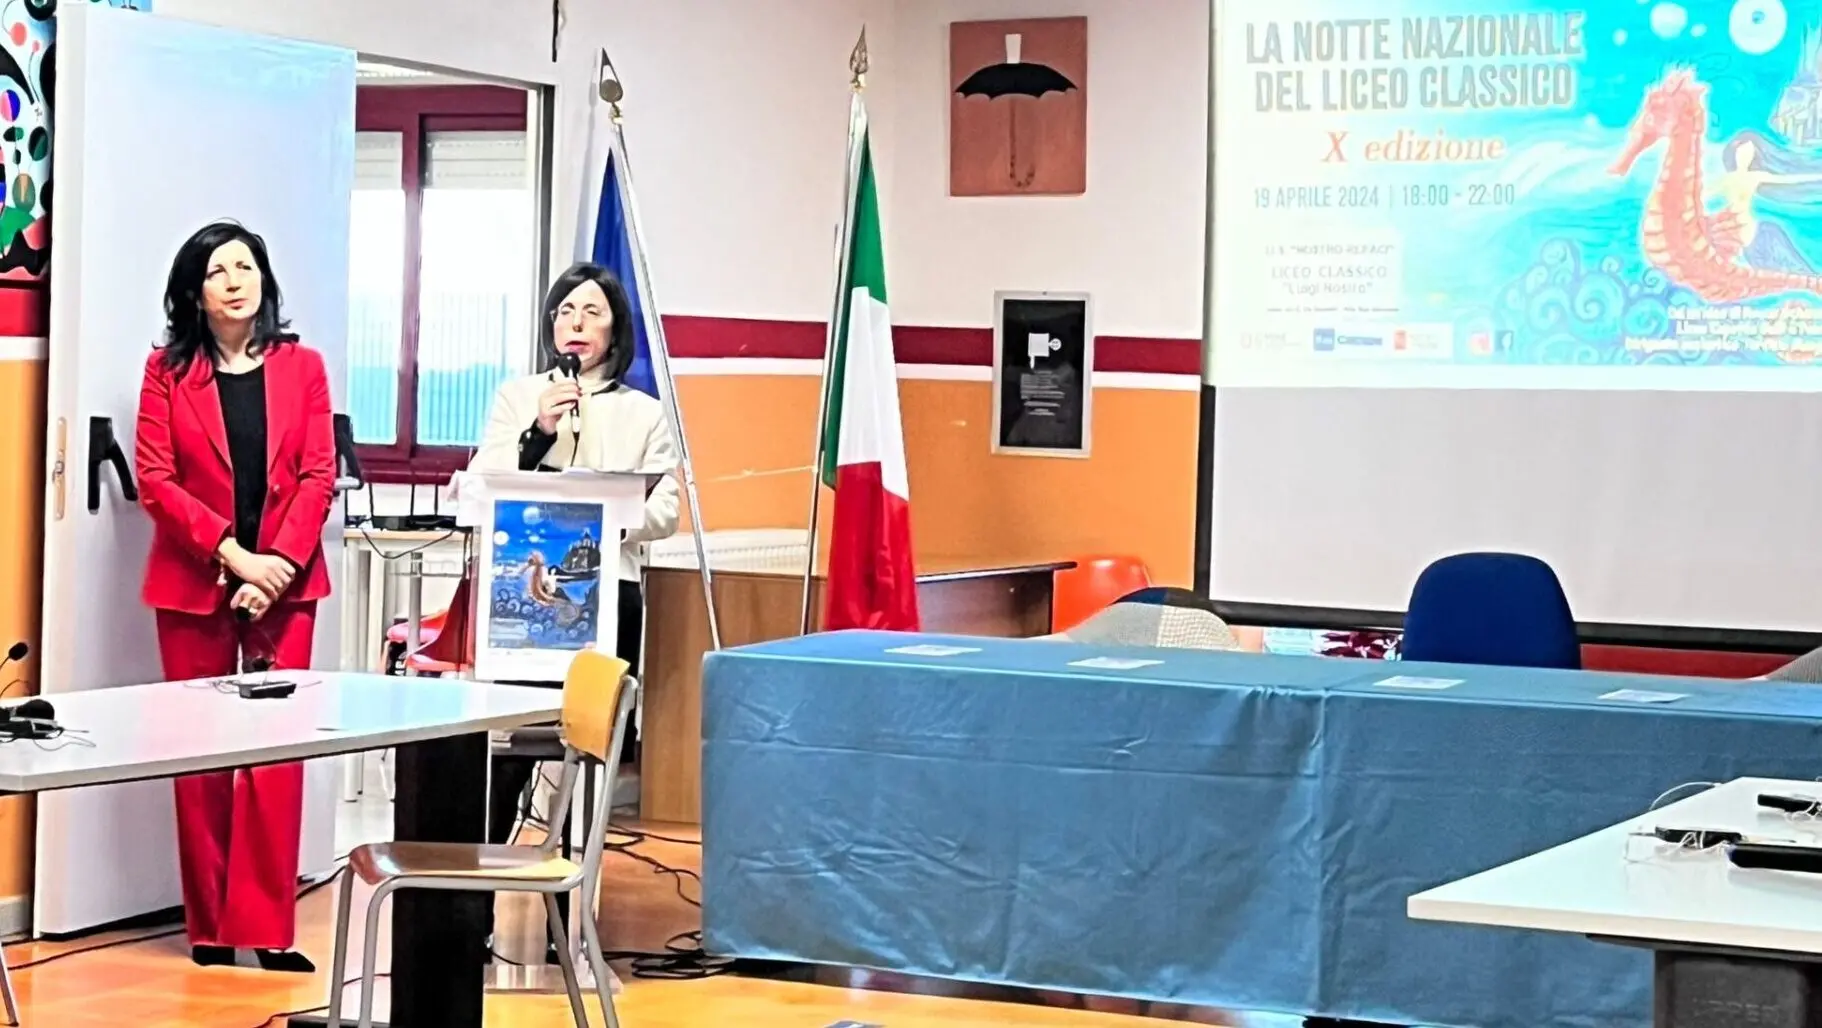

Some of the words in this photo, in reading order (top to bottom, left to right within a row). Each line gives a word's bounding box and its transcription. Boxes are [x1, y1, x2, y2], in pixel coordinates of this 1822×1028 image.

[1246, 21, 1284, 63] LA
[1293, 18, 1391, 62] NOTTE
[1402, 11, 1583, 59] NAZIONALE
[1255, 70, 1311, 112] DEL
[1322, 67, 1408, 111] LICEO
[1419, 62, 1574, 109] CLASSICO
[1321, 131, 1349, 163] X
[1364, 129, 1506, 162] edizione
[1254, 187, 1271, 208] 19
[1276, 186, 1332, 208] APRILE
[1338, 185, 1379, 208] 2024
[1402, 183, 1449, 206] 18:00
[1467, 183, 1515, 206] 22:00
[1271, 265, 1312, 279] LICEO
[1318, 265, 1388, 279] CLASSICO
